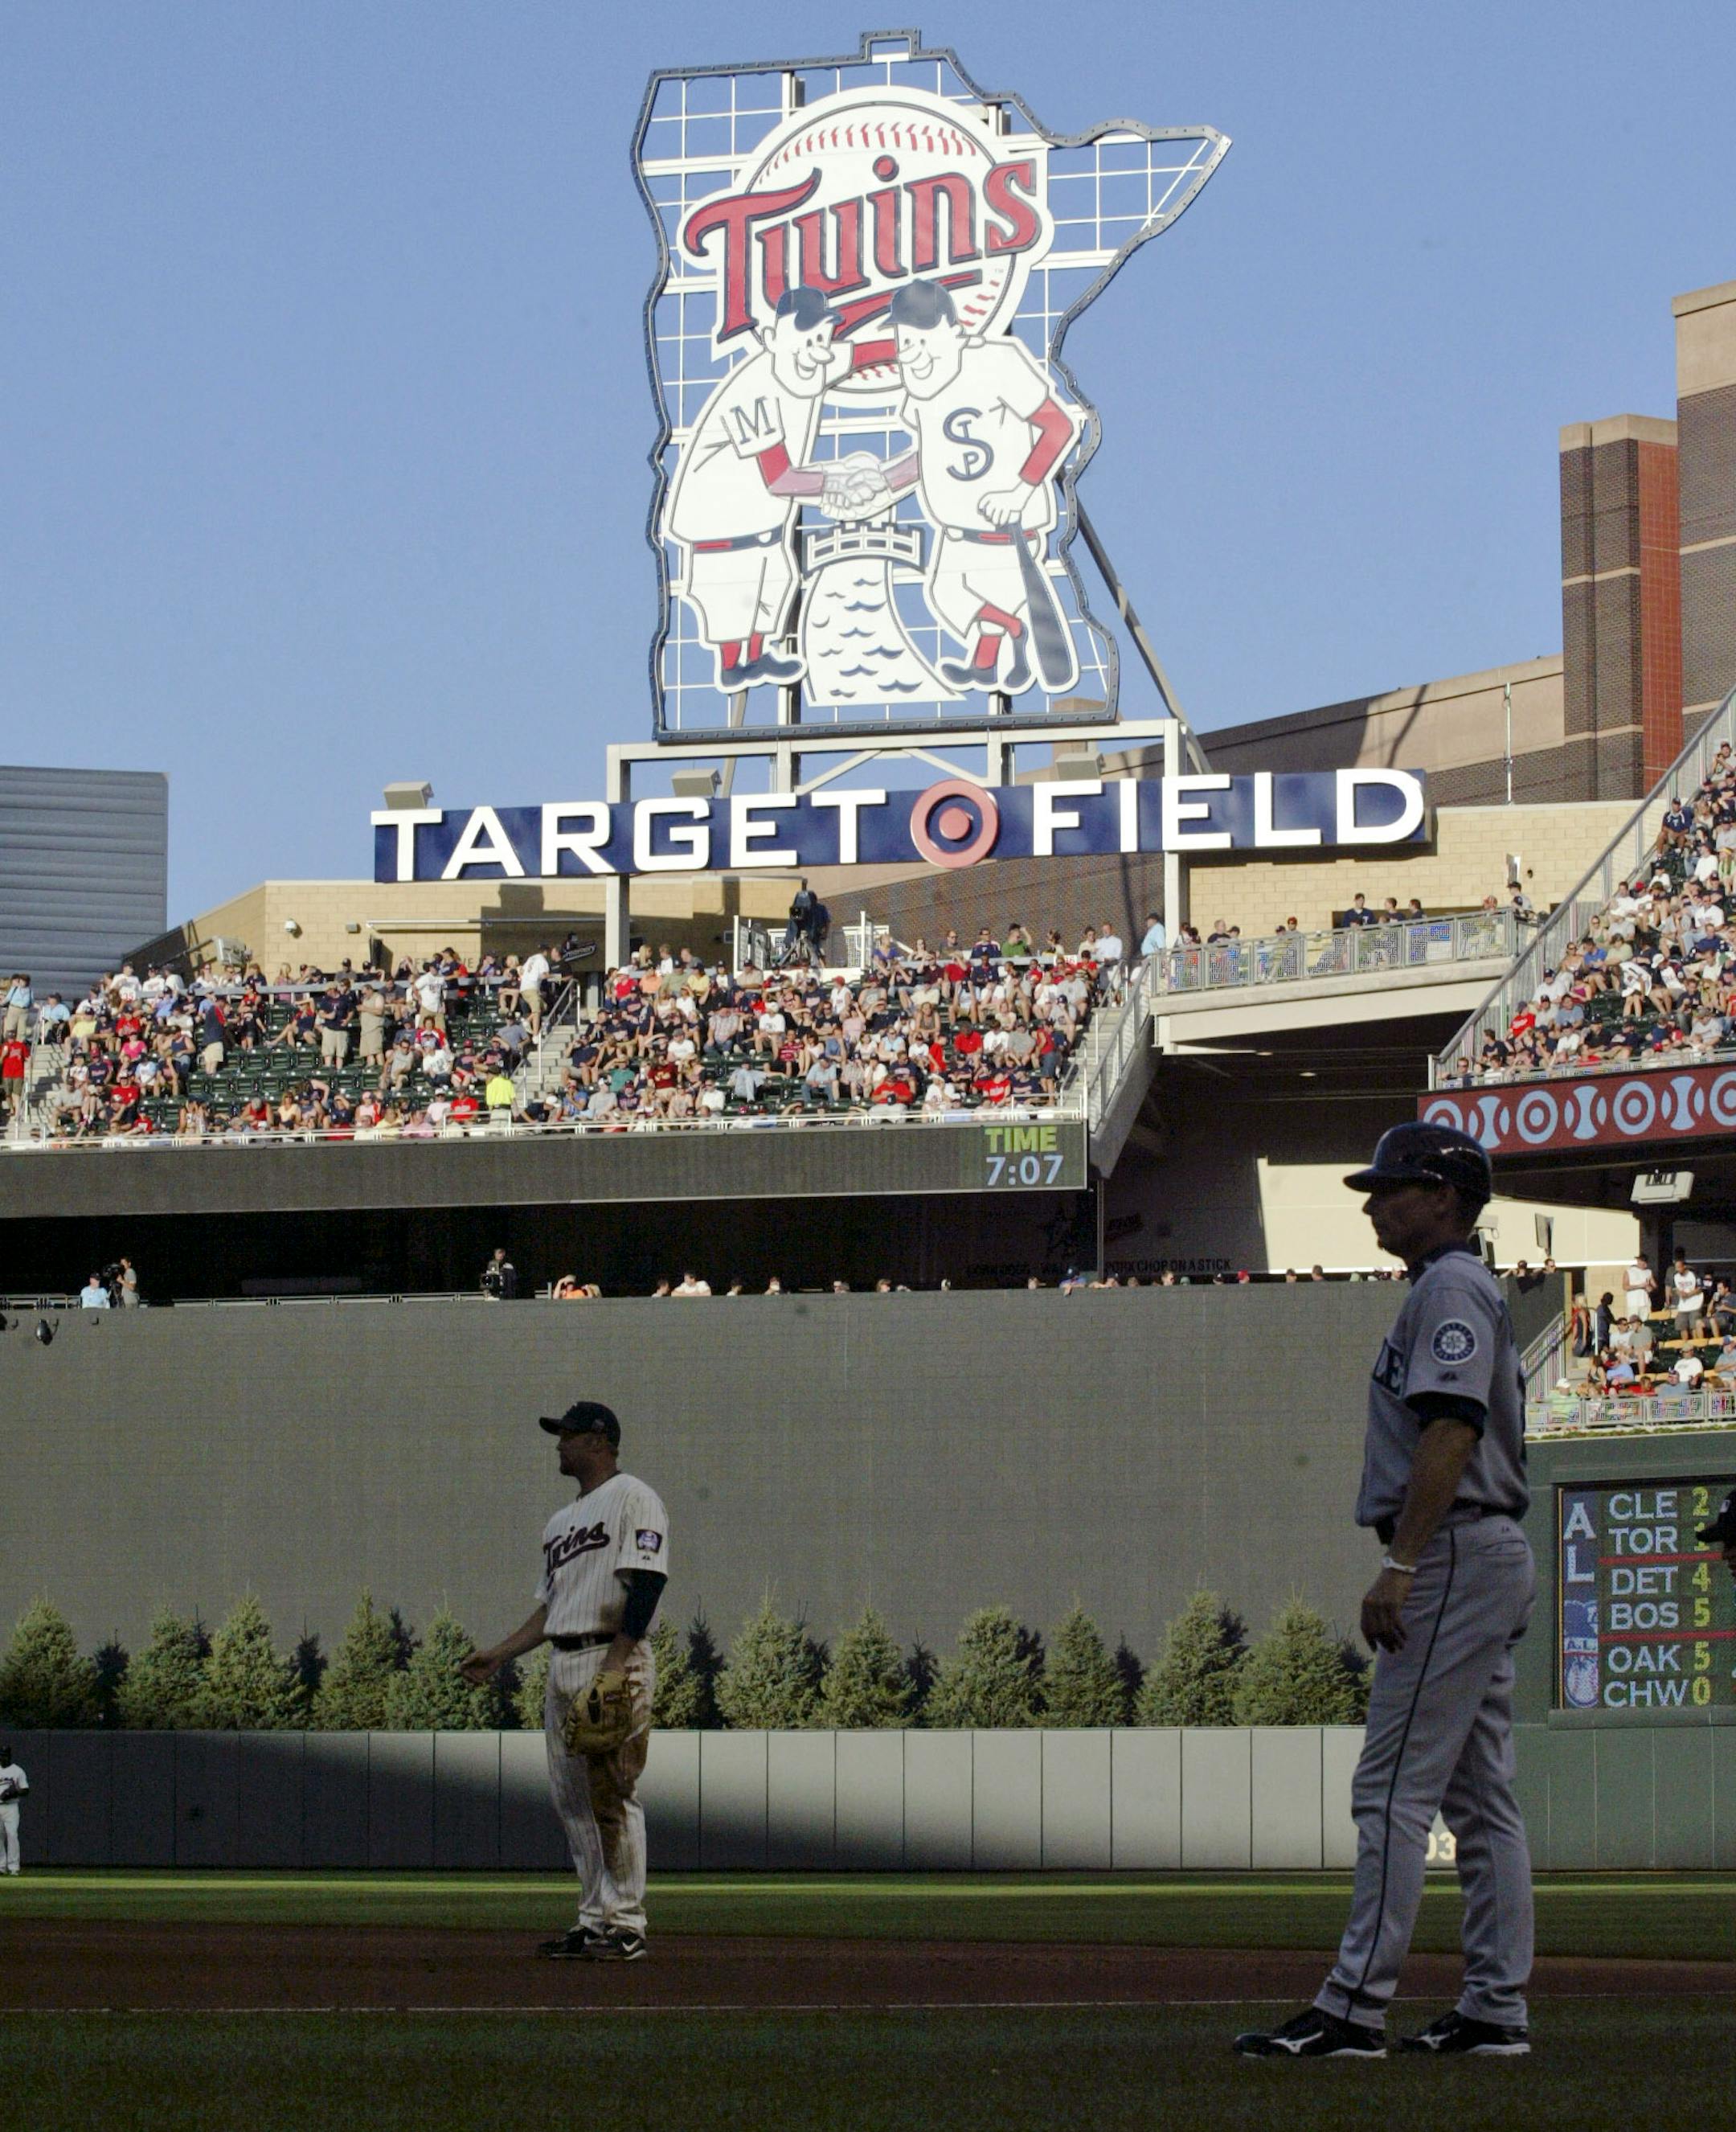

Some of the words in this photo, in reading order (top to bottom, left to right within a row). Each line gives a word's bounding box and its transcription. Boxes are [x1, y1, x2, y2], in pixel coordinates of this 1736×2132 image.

[683, 154, 1042, 342] Twins
[371, 789, 886, 882] TARGET
[1034, 769, 1424, 855] FIELD
[985, 1125, 1058, 1153] TIME
[985, 1154, 1063, 1186] 7:07
[1609, 1490, 1678, 1520] CLE
[1692, 1486, 1709, 1516] 2
[1608, 1526, 1678, 1555] TOR
[1611, 1565, 1678, 1595] DET
[1692, 1563, 1711, 1593] 4
[1611, 1601, 1679, 1630] BOS
[1693, 1598, 1710, 1627] 5
[1608, 1645, 1681, 1674] OAK
[1693, 1642, 1710, 1671] 5
[1603, 1679, 1688, 1708] CHW
[1693, 1676, 1711, 1706] 0
